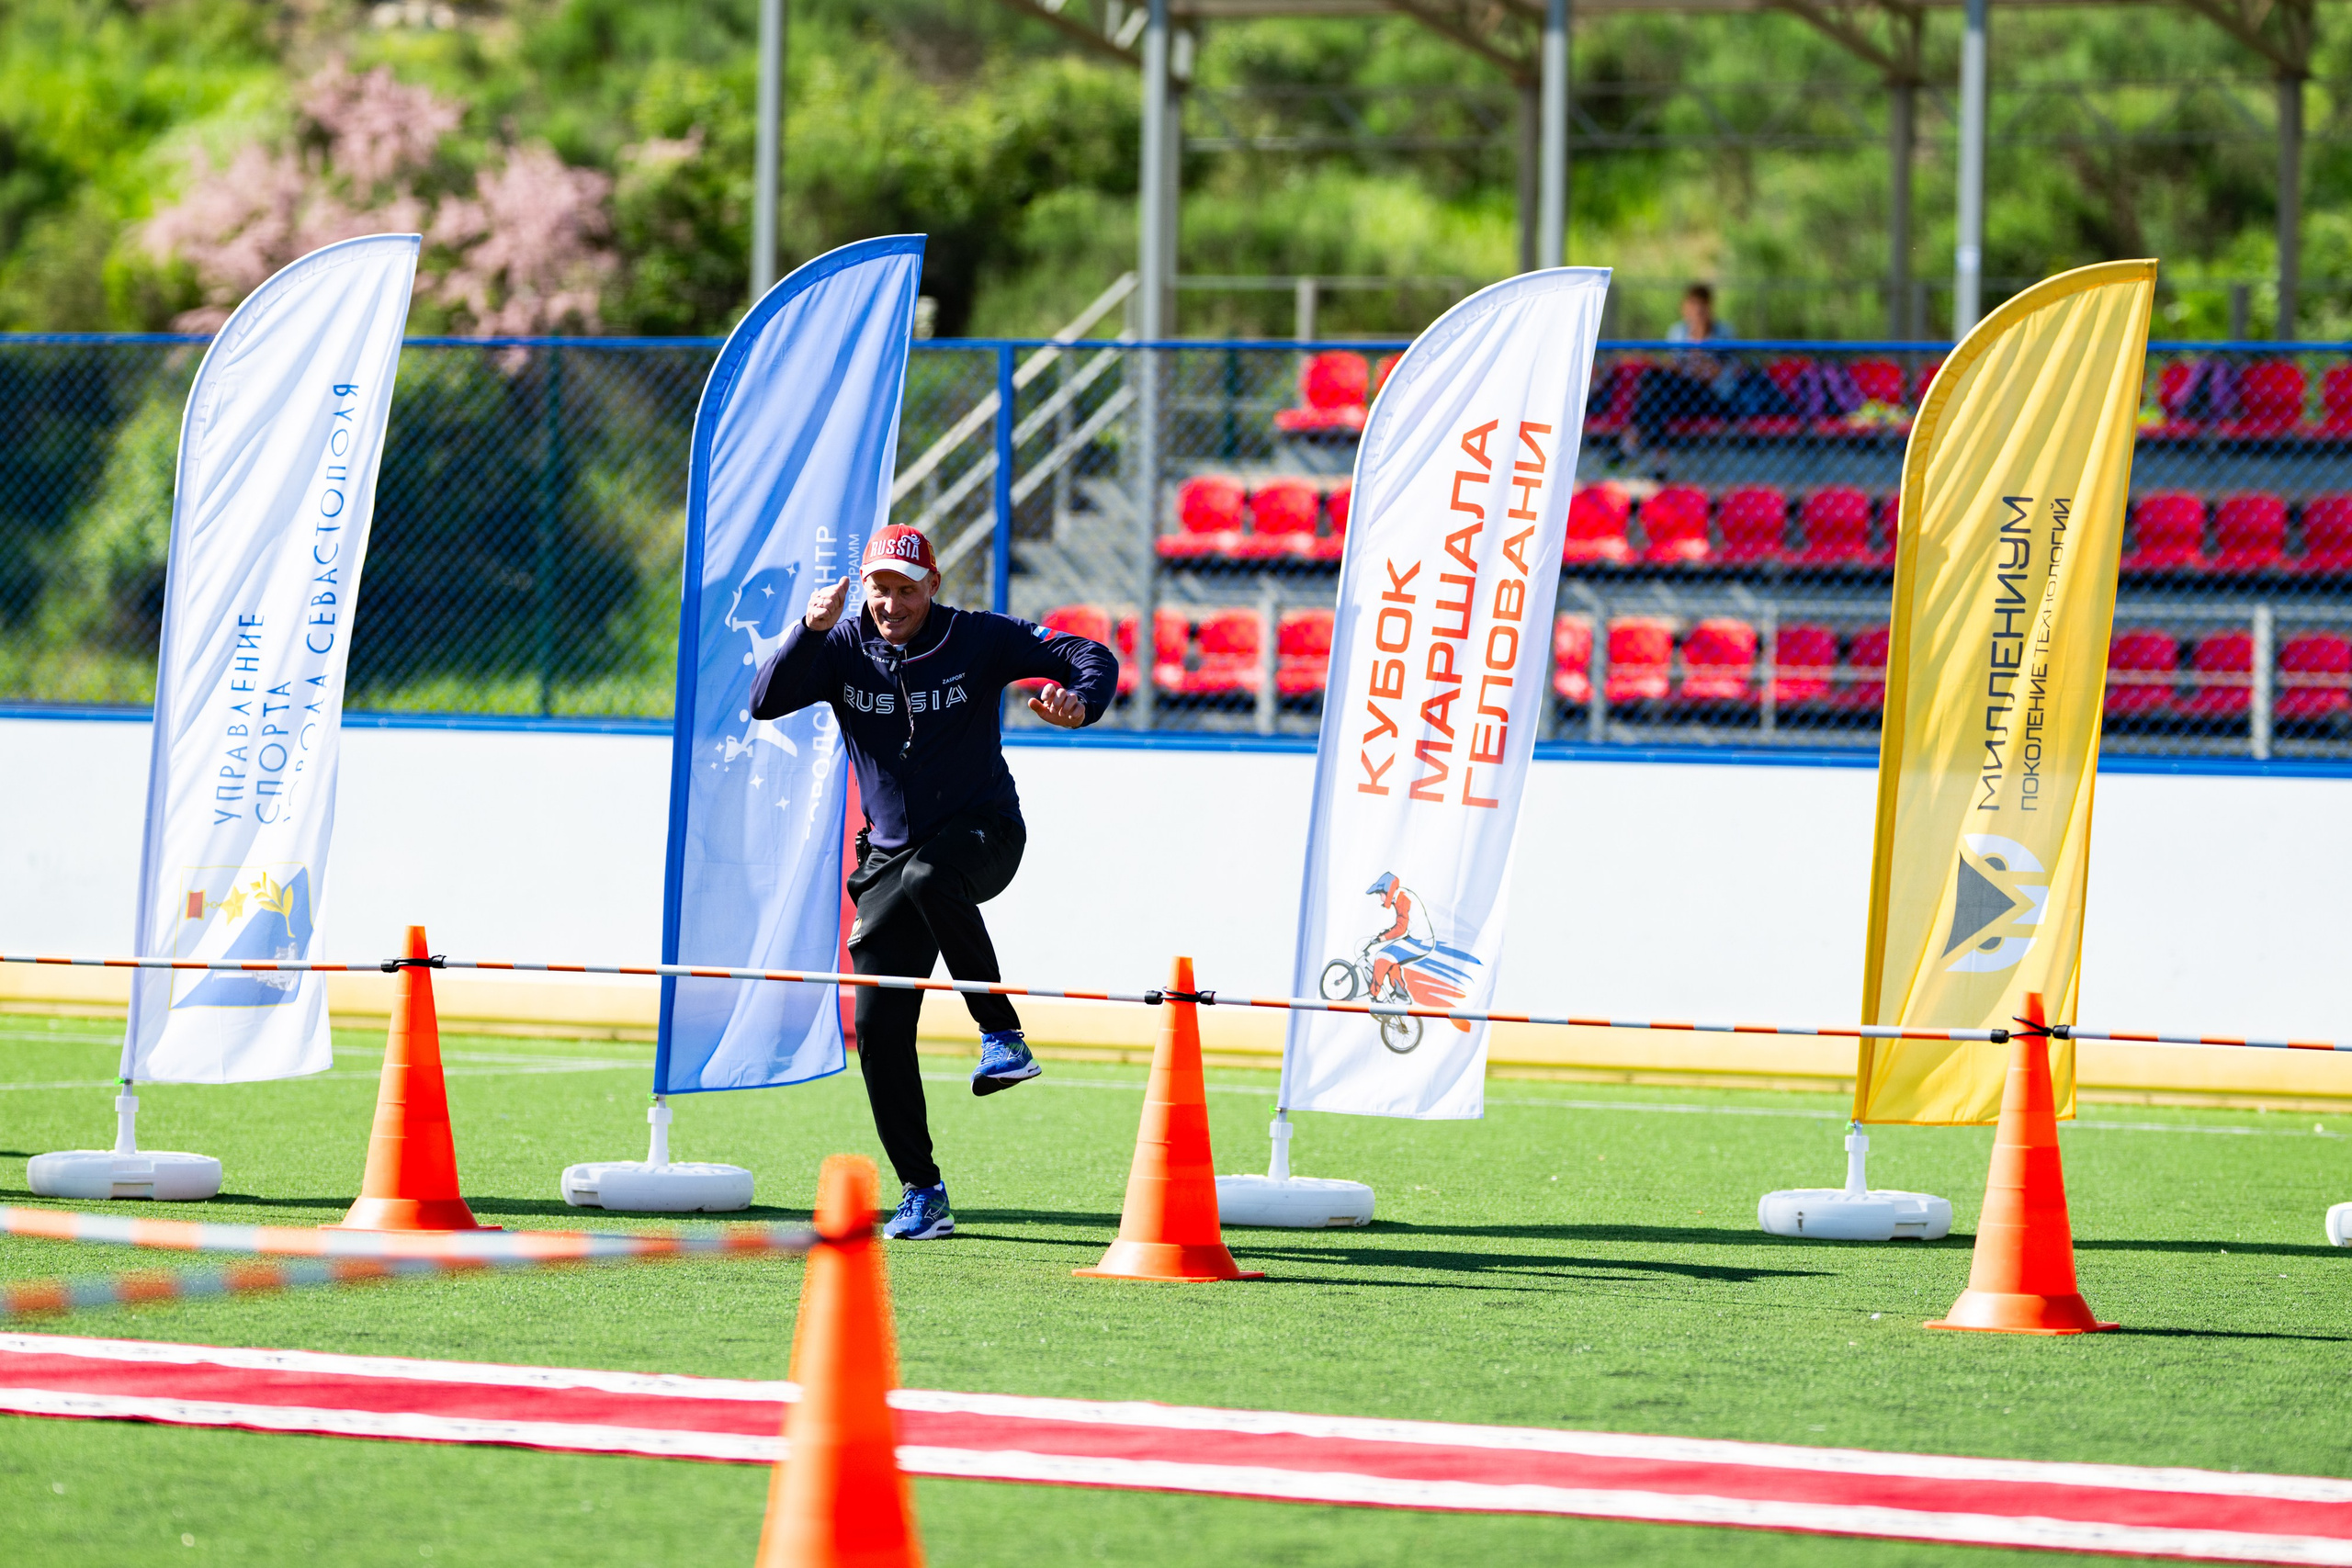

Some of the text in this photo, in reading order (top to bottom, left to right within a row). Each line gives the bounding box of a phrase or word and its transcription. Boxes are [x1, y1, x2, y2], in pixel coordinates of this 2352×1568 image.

[306, 384, 359, 654] СЕВАСТОПОЛЯ
[848, 533, 860, 612] ПРОГРАММ
[869, 536, 920, 561] RUSSIA
[1408, 418, 1499, 803] МАРШАЛА
[1462, 420, 1553, 809] ГЕЛОВАНИ
[213, 614, 265, 826] УПРАВЛЕНИЕ
[254, 681, 292, 825] СПОРТА
[843, 682, 968, 715] RUSSIA
[942, 672, 966, 685] ZASPORT
[1357, 557, 1421, 796] КУБОК
[1976, 495, 2034, 812] МИЛЛЕНИУМ
[2020, 498, 2071, 811] ПОКОЛЕНИЕ ТЕХНОЛОГИЙ
